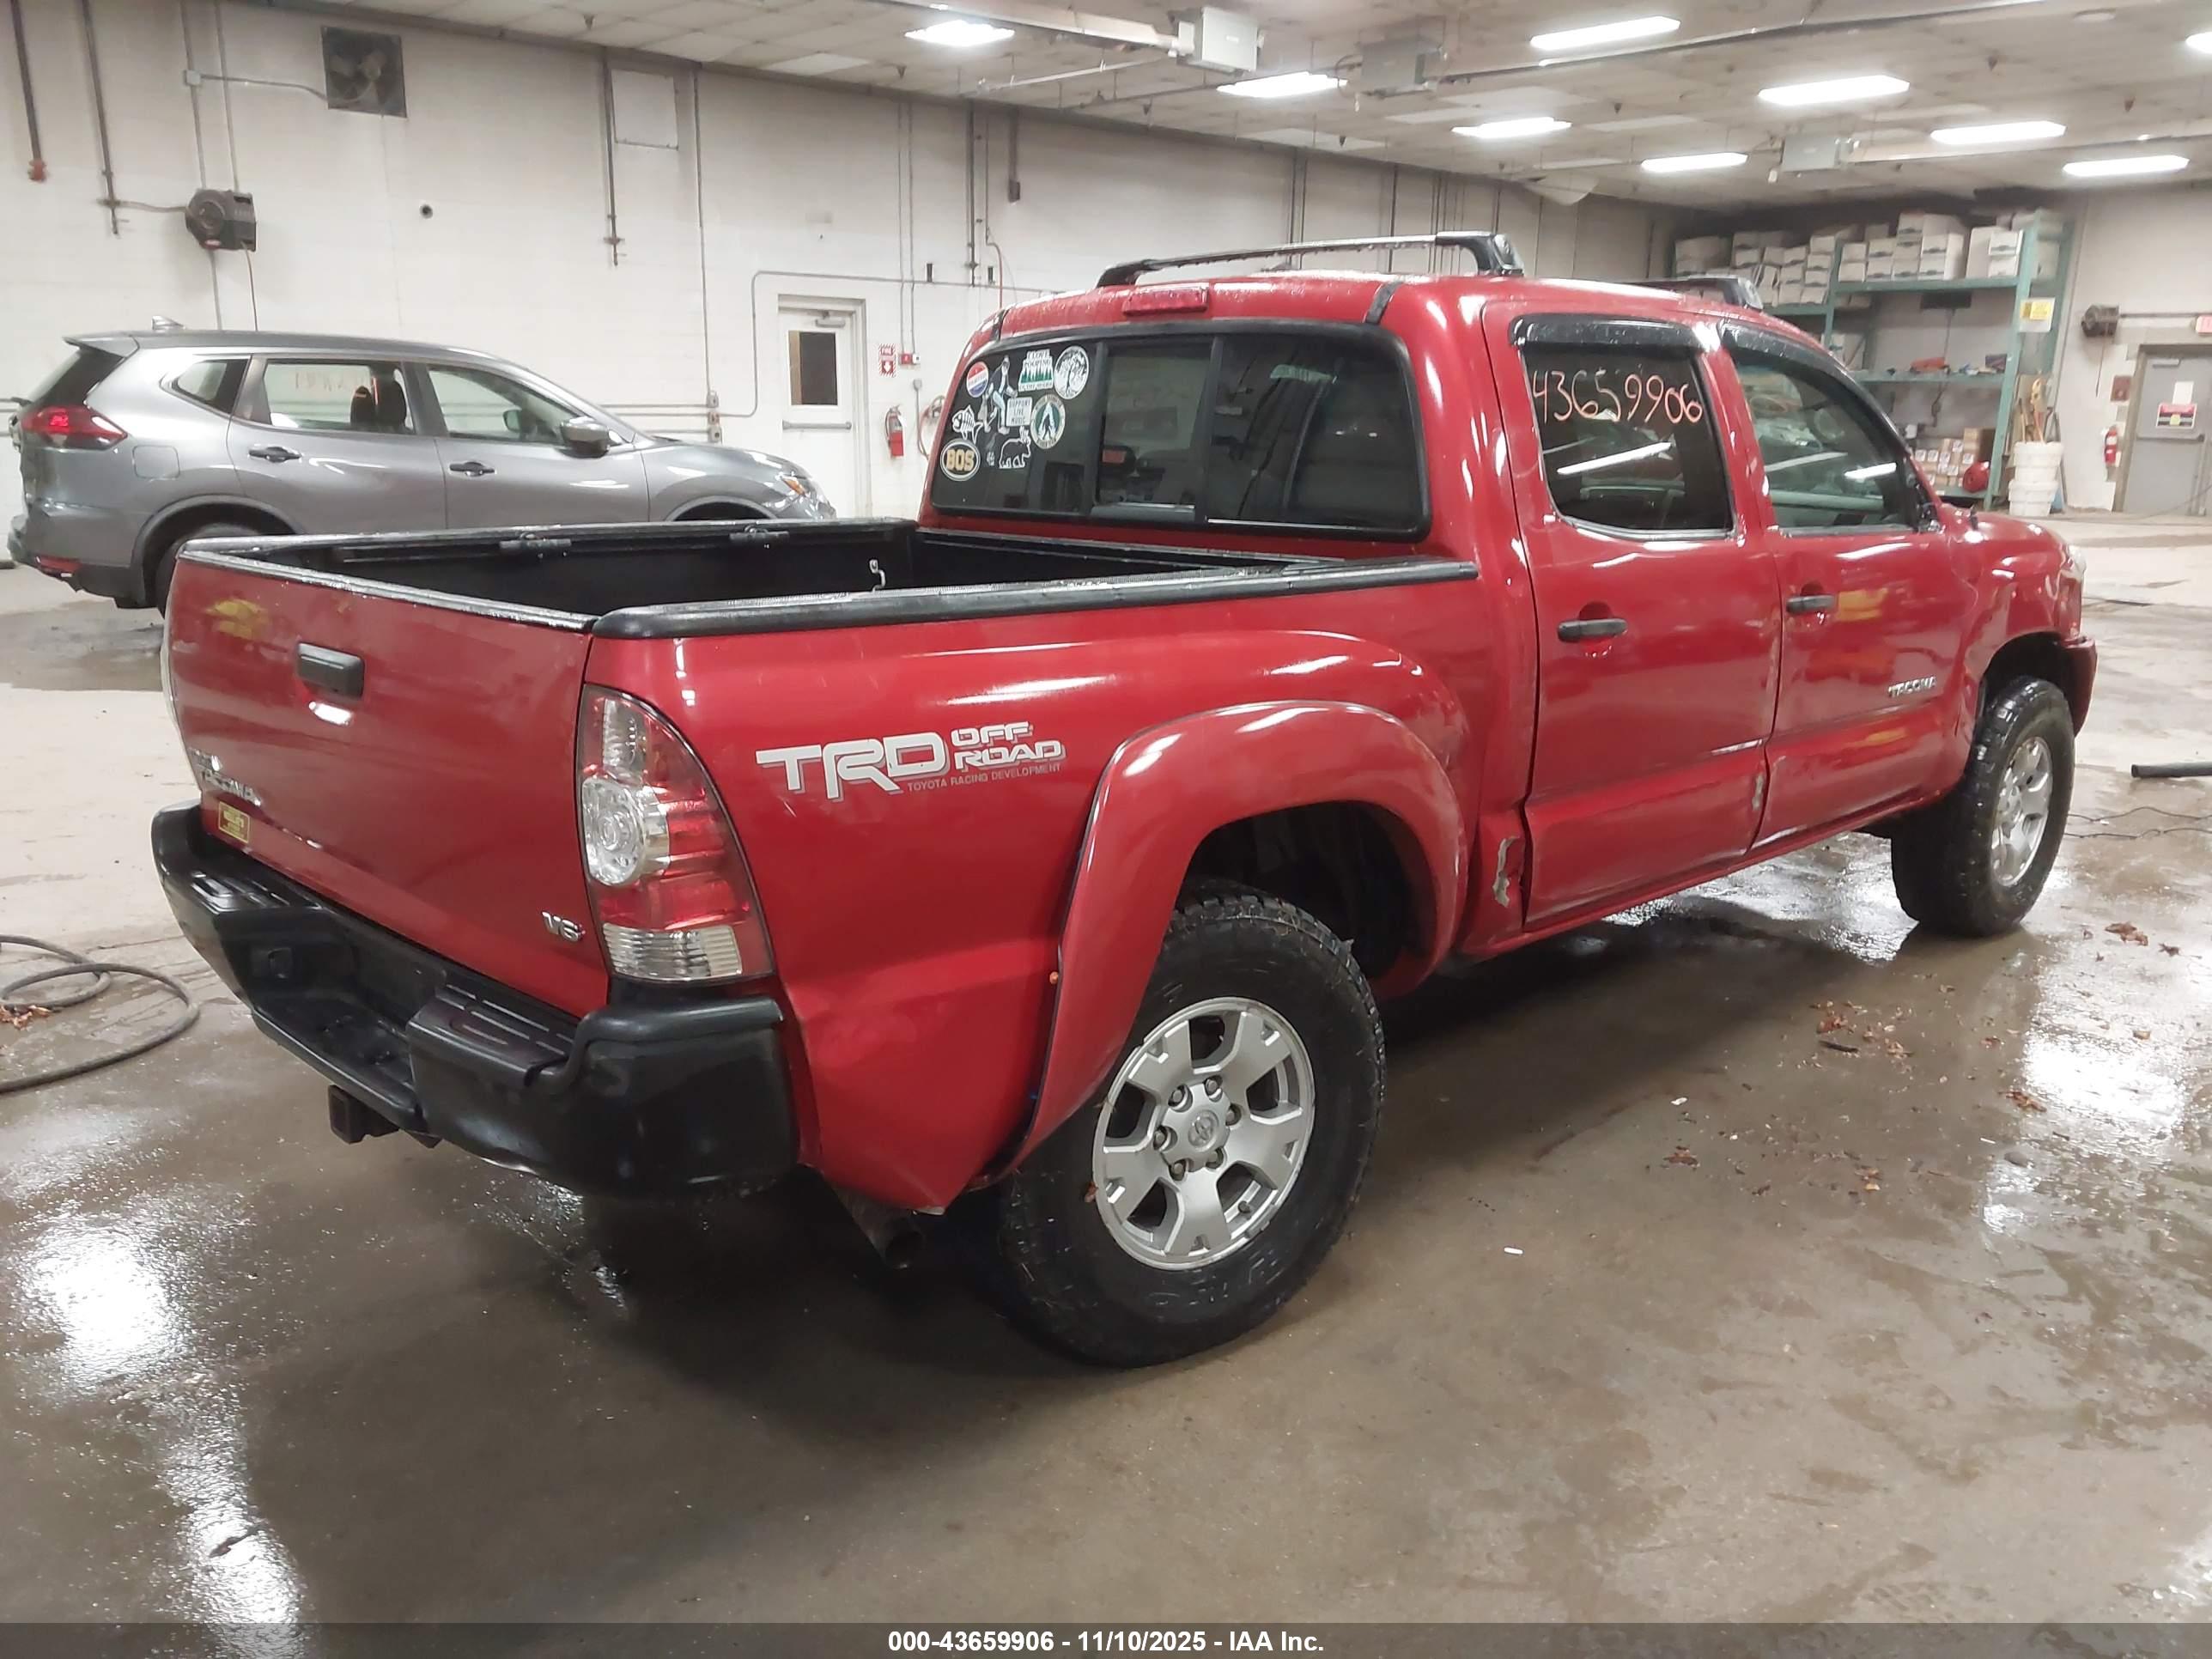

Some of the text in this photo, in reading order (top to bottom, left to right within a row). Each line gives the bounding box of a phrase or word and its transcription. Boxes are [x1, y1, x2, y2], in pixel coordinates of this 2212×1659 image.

[1009, 398, 1030, 406] SUPPORT
[1533, 367, 1703, 423] 43659906
[1012, 416, 1025, 425] MUSIC
[946, 448, 975, 471] BOS
[951, 721, 1032, 747] OFF
[756, 732, 948, 800] TRD
[954, 740, 1064, 770] ROAD
[907, 763, 1060, 792] TOYOTA RACING DEVELOPMENT
[541, 911, 580, 942] V6
